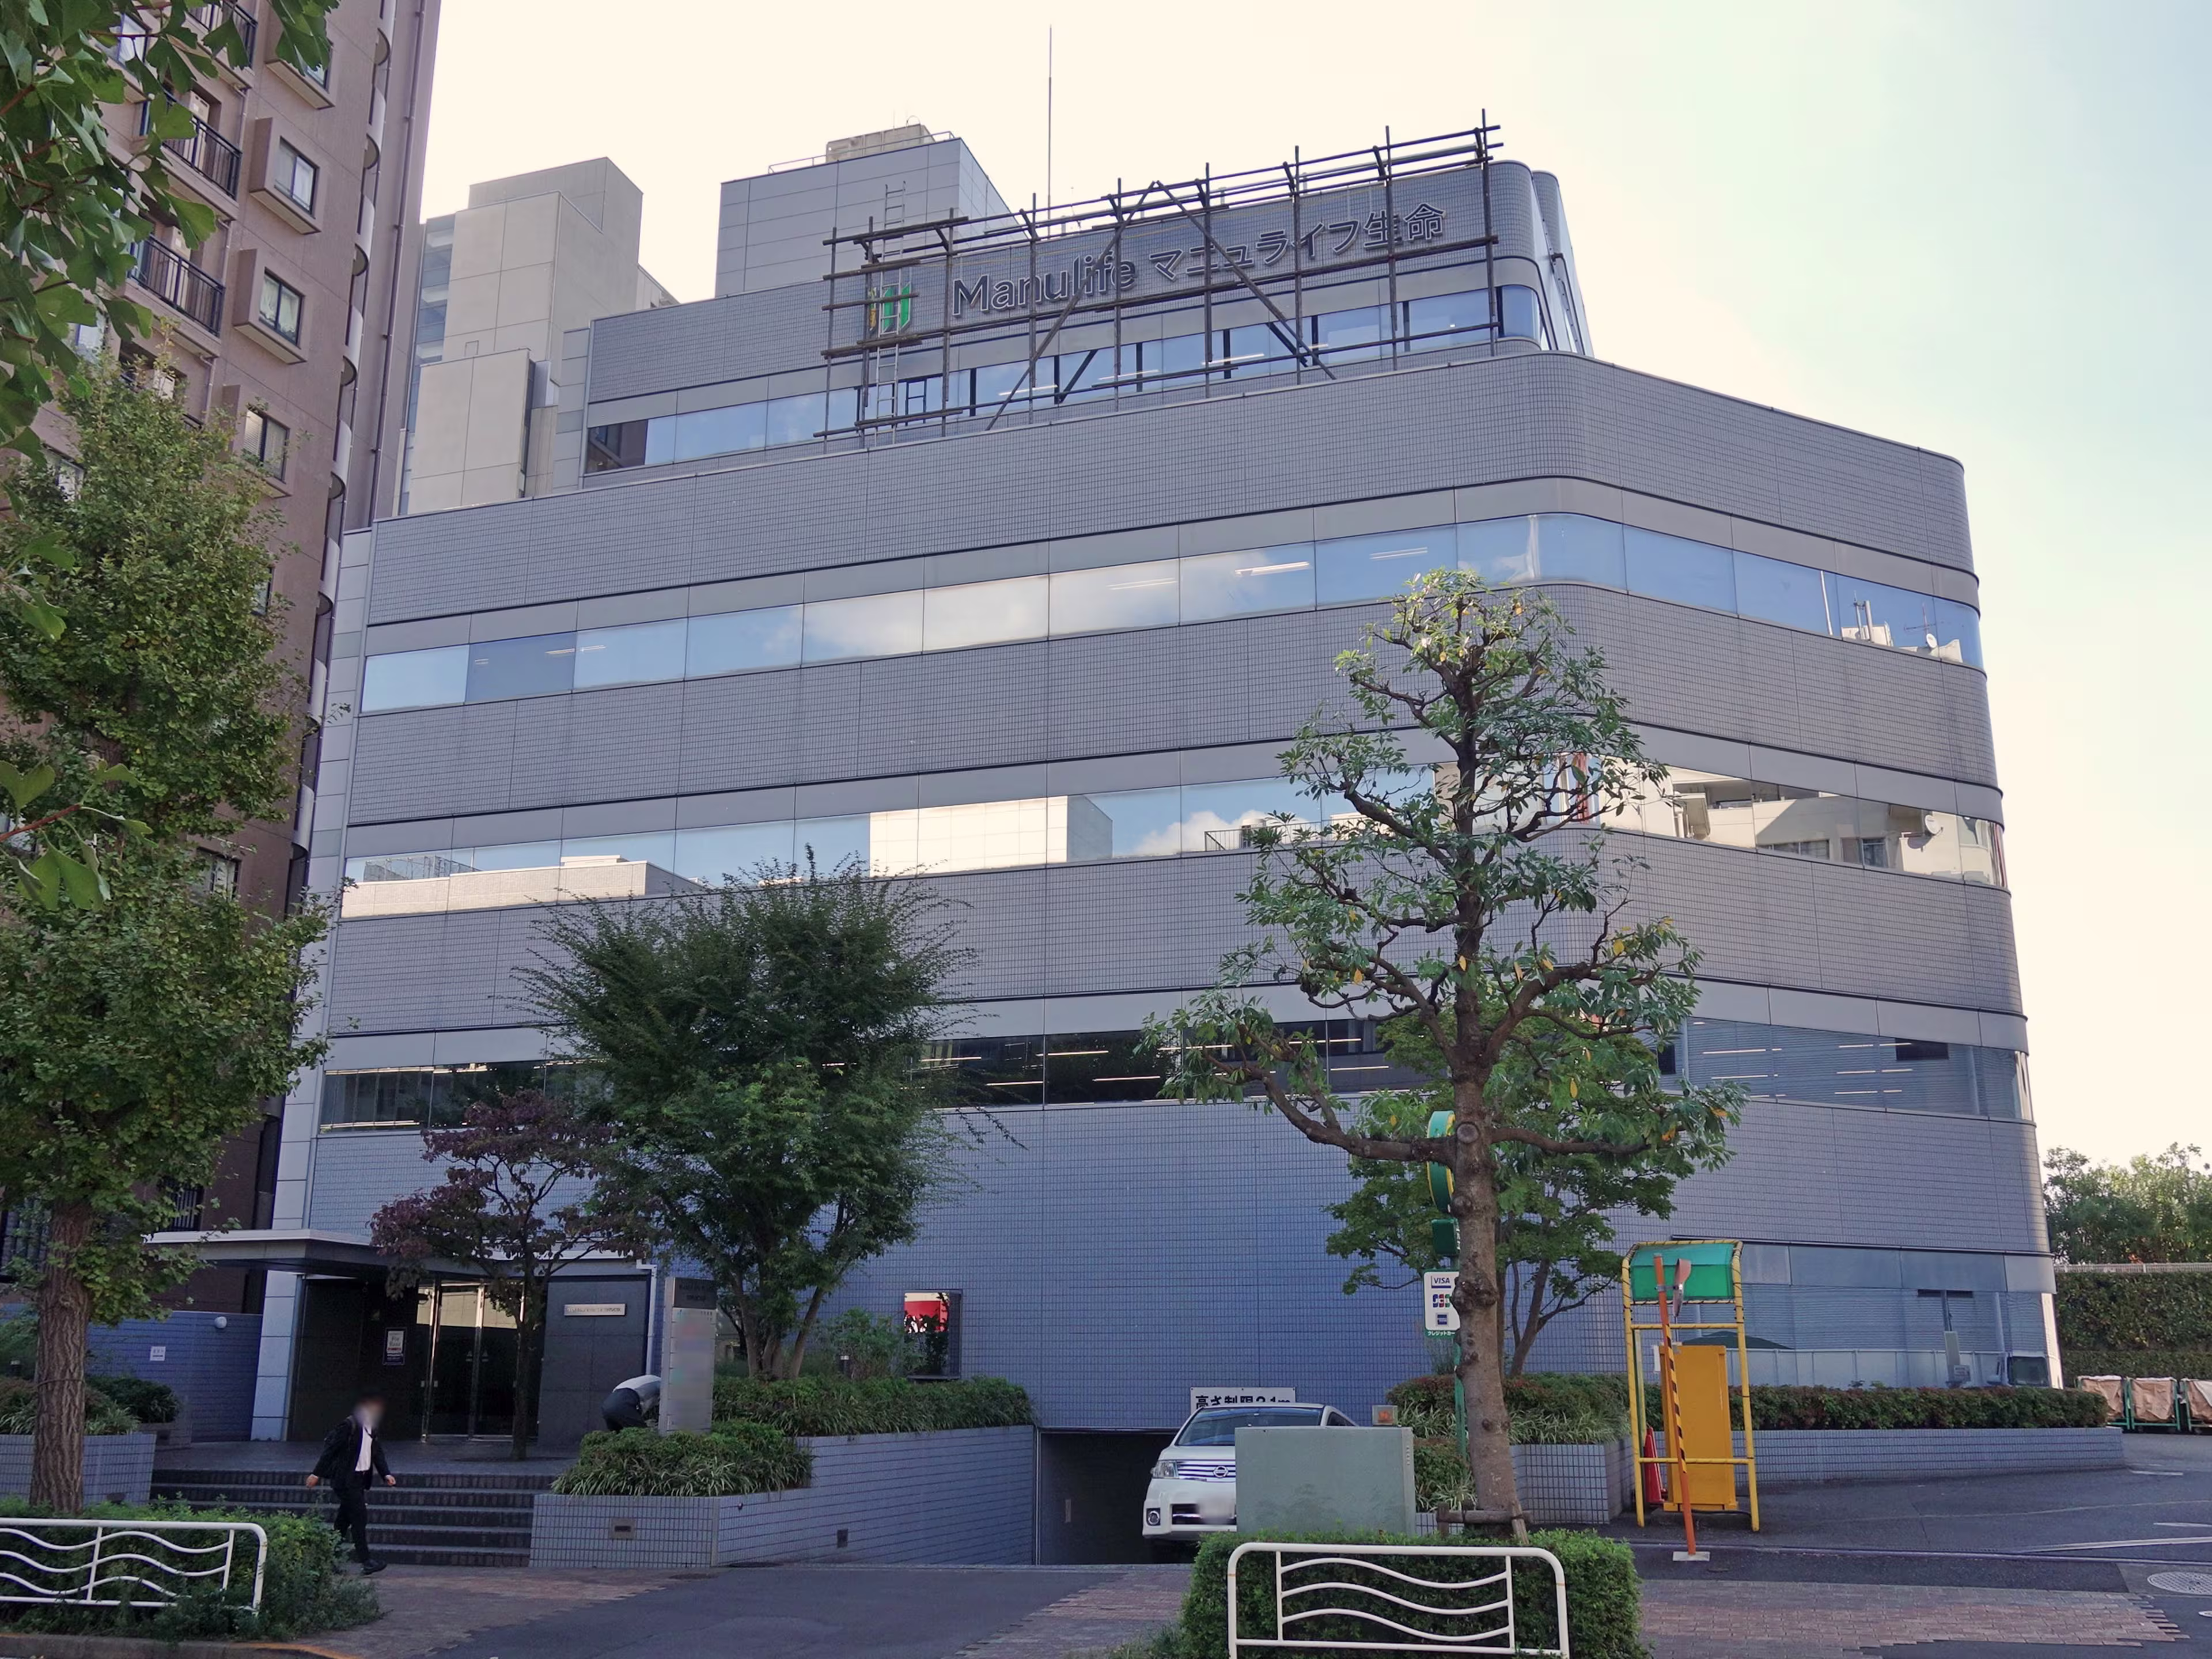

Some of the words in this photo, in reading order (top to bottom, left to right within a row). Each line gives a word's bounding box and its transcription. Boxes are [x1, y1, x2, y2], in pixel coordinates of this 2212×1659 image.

[952, 254, 1137, 317] Manulife
[1149, 203, 1446, 281] マニュライフ生命
[1433, 1294, 1450, 1308] JCB
